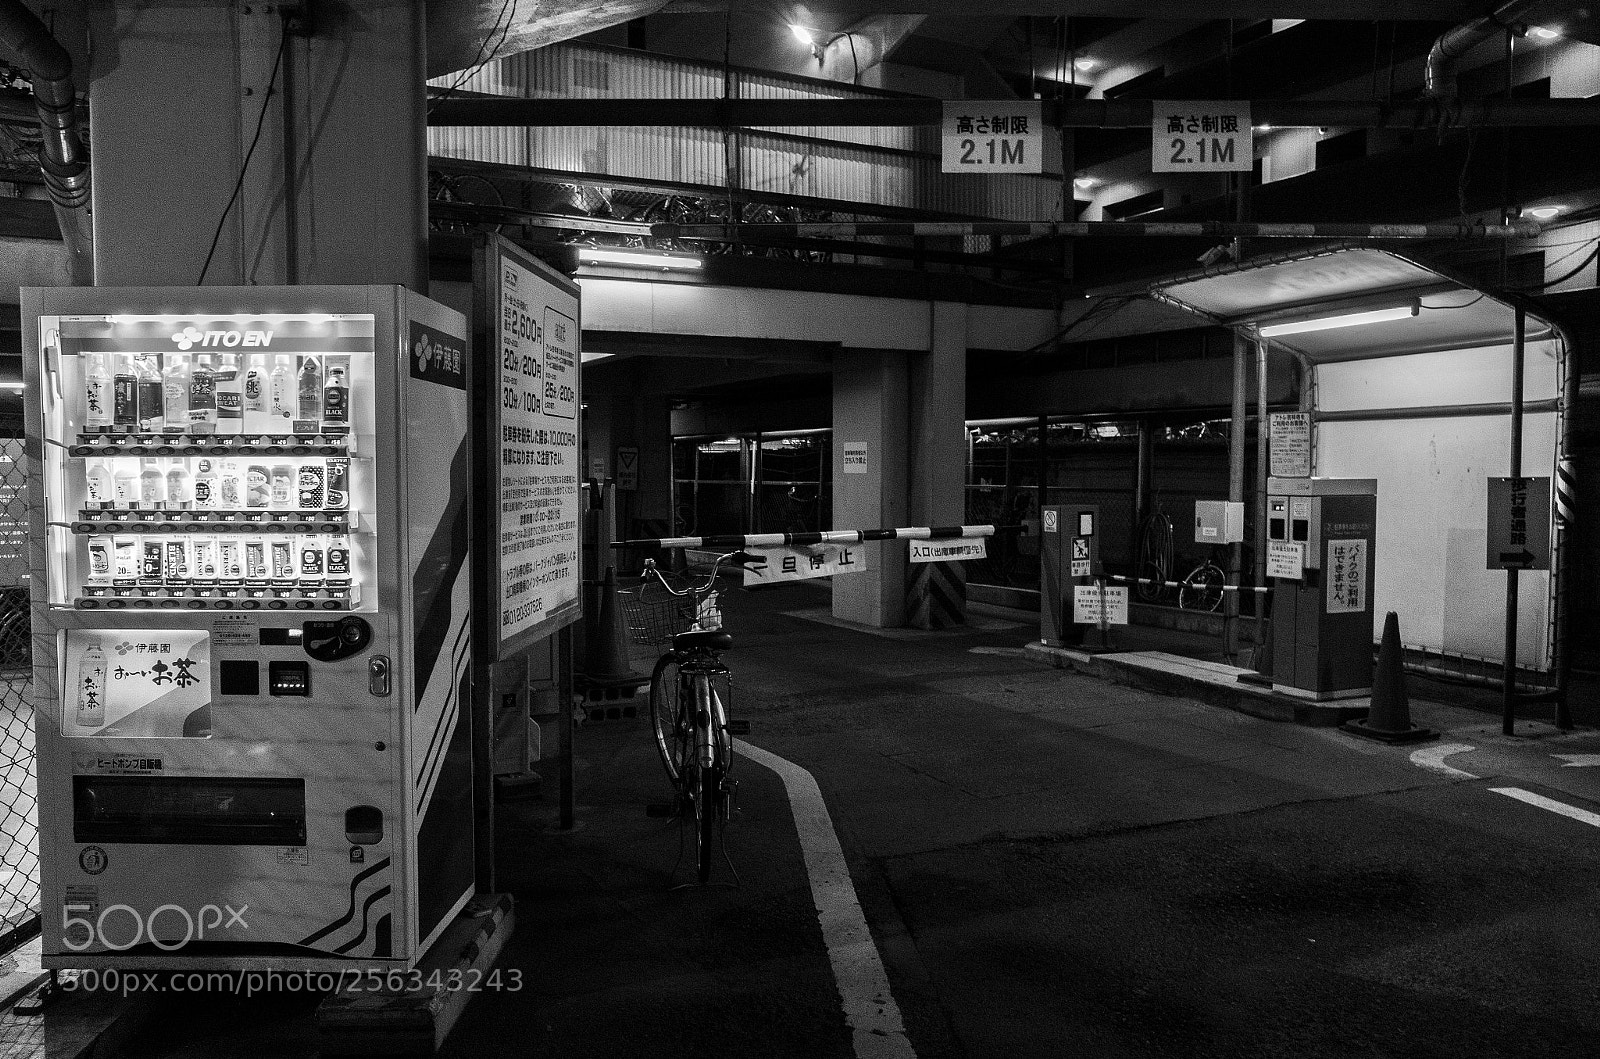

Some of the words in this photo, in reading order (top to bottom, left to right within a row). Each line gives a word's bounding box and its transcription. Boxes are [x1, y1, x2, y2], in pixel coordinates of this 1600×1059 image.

[956, 115, 1029, 134] 高さ制限
[1166, 115, 1239, 134] 高さ制限
[960, 139, 1024, 164] 2.1M
[1170, 138, 1235, 163] 2.1M
[202, 331, 242, 347] ITO
[241, 331, 274, 347] EN
[512, 310, 542, 344] 2,600円
[433, 342, 461, 374] 伊藤園
[1333, 545, 1345, 605] はできません。
[1347, 543, 1360, 608] バイクのご利用
[135, 643, 171, 654] 伊藤園
[97, 758, 163, 770] ヒートポンプ自販機
